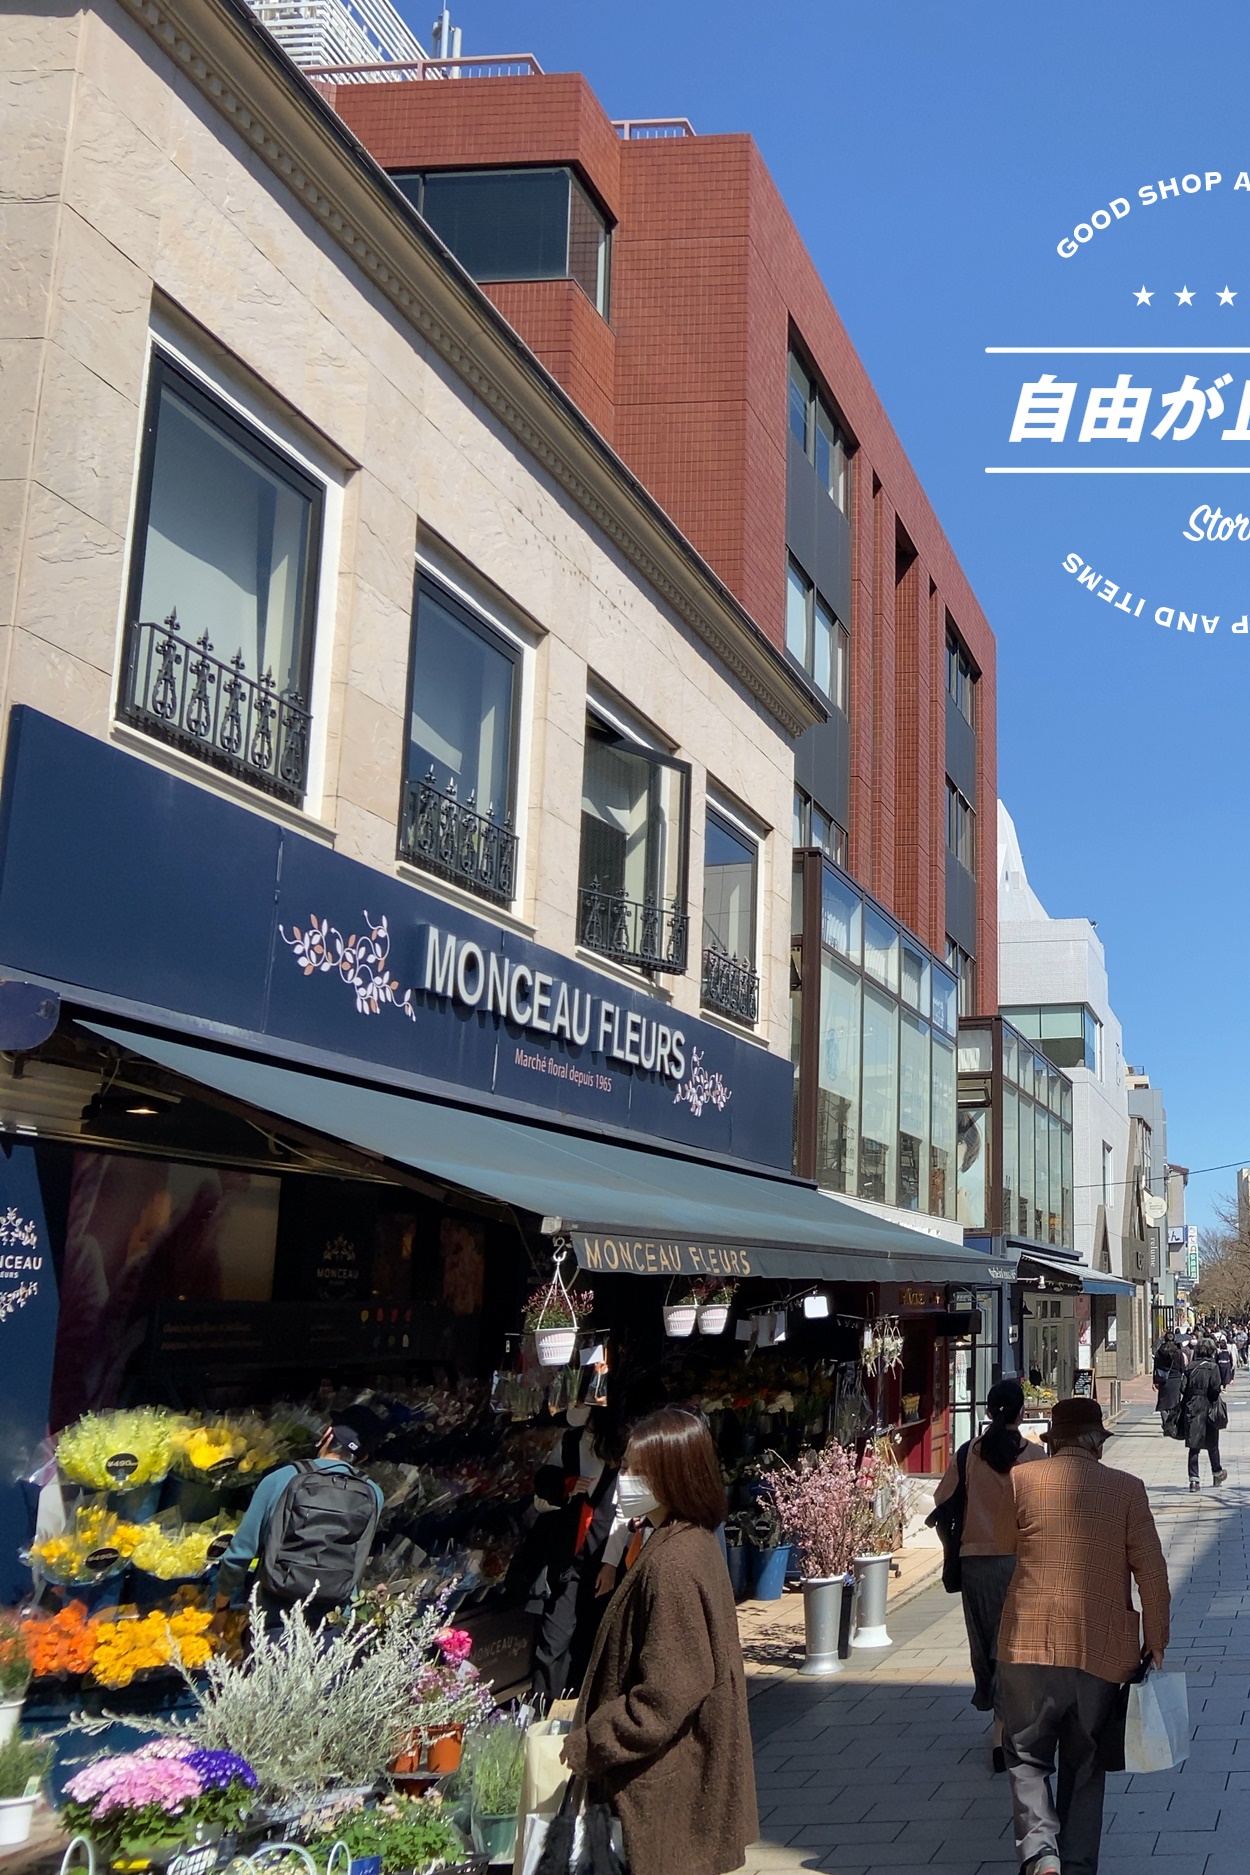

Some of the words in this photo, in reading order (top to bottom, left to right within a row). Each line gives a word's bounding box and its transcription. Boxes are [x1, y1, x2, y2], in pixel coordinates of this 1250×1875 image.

[424, 926, 591, 1046] MONCEAU
[598, 1000, 686, 1080] FLEURS
[514, 1047, 547, 1073] Marché
[548, 1057, 568, 1078] floral
[569, 1066, 594, 1088] depuis
[595, 1074, 612, 1092] 1965
[584, 1237, 681, 1272] MONCEAU
[688, 1246, 750, 1275] FLEURS
[1150, 1237, 1158, 1268] relume
[316, 1267, 360, 1279] MONCEAU
